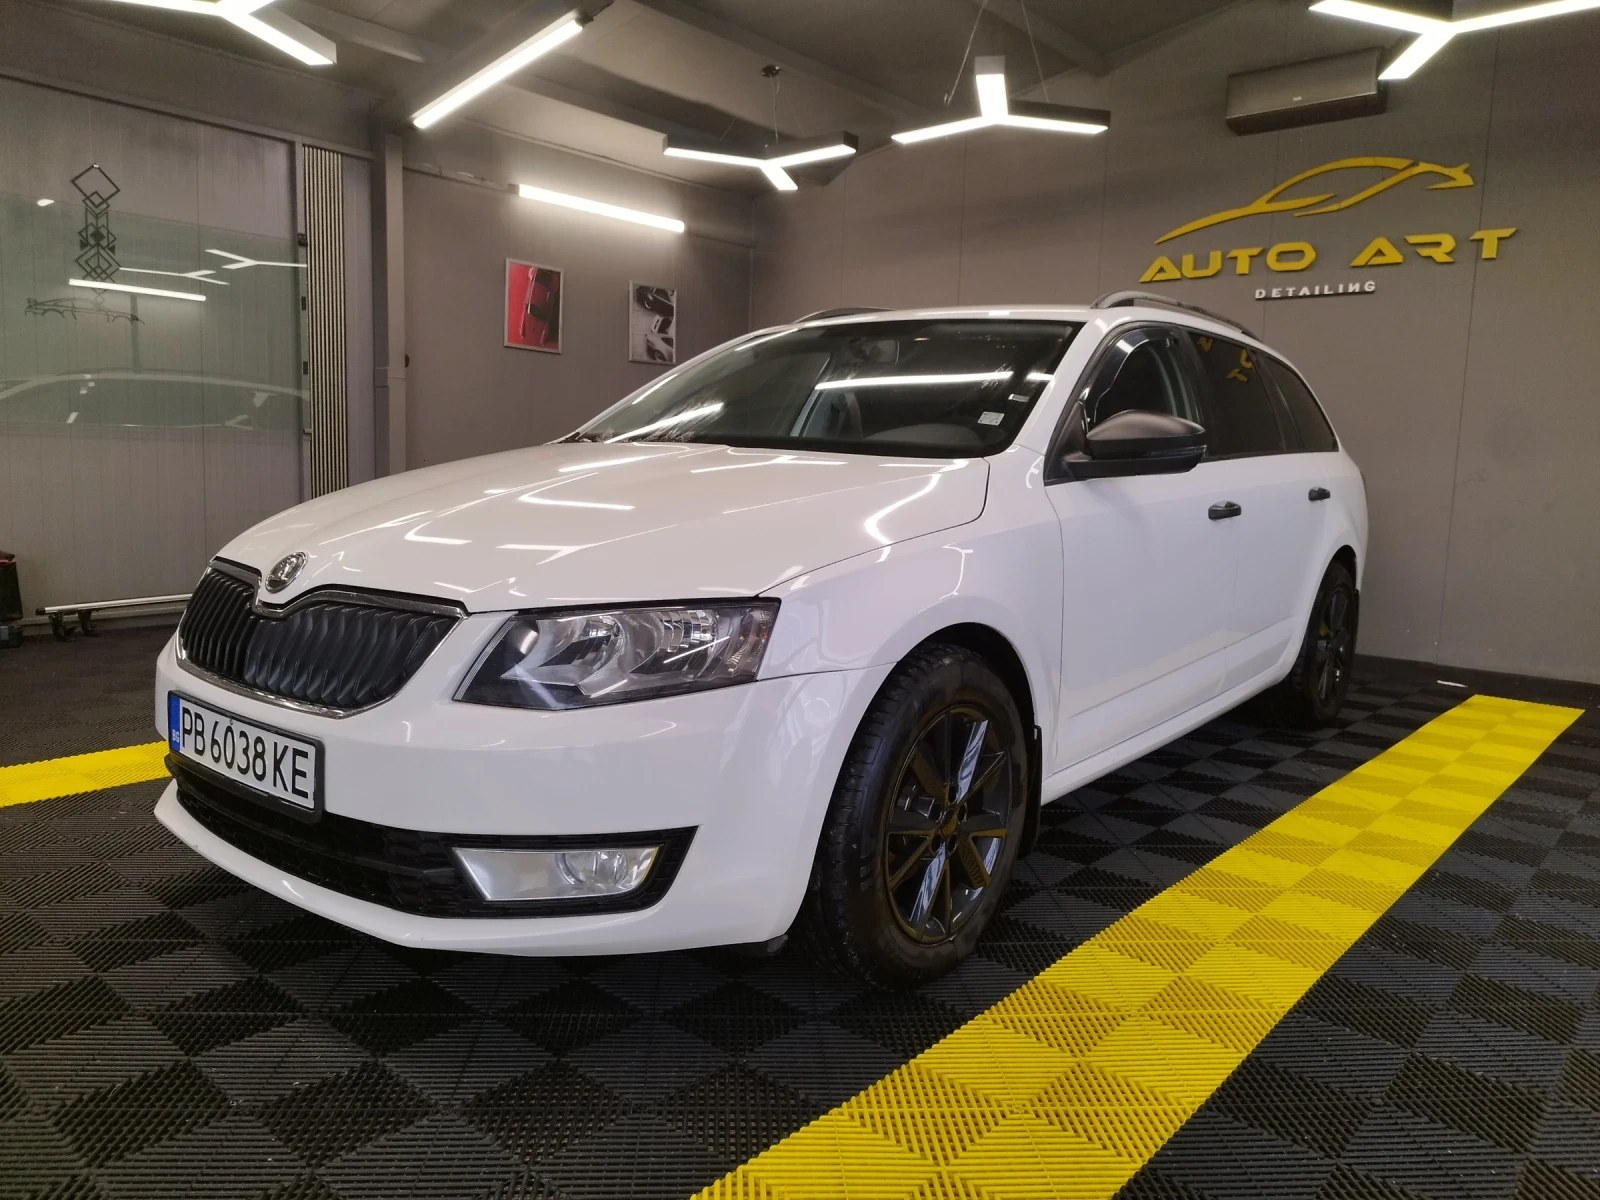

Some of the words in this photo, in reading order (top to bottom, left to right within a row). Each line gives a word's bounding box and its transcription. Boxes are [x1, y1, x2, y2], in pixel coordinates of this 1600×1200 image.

[1139, 241, 1317, 283] AUTO
[1350, 227, 1517, 268] ART
[1254, 280, 1377, 300] DETAILING
